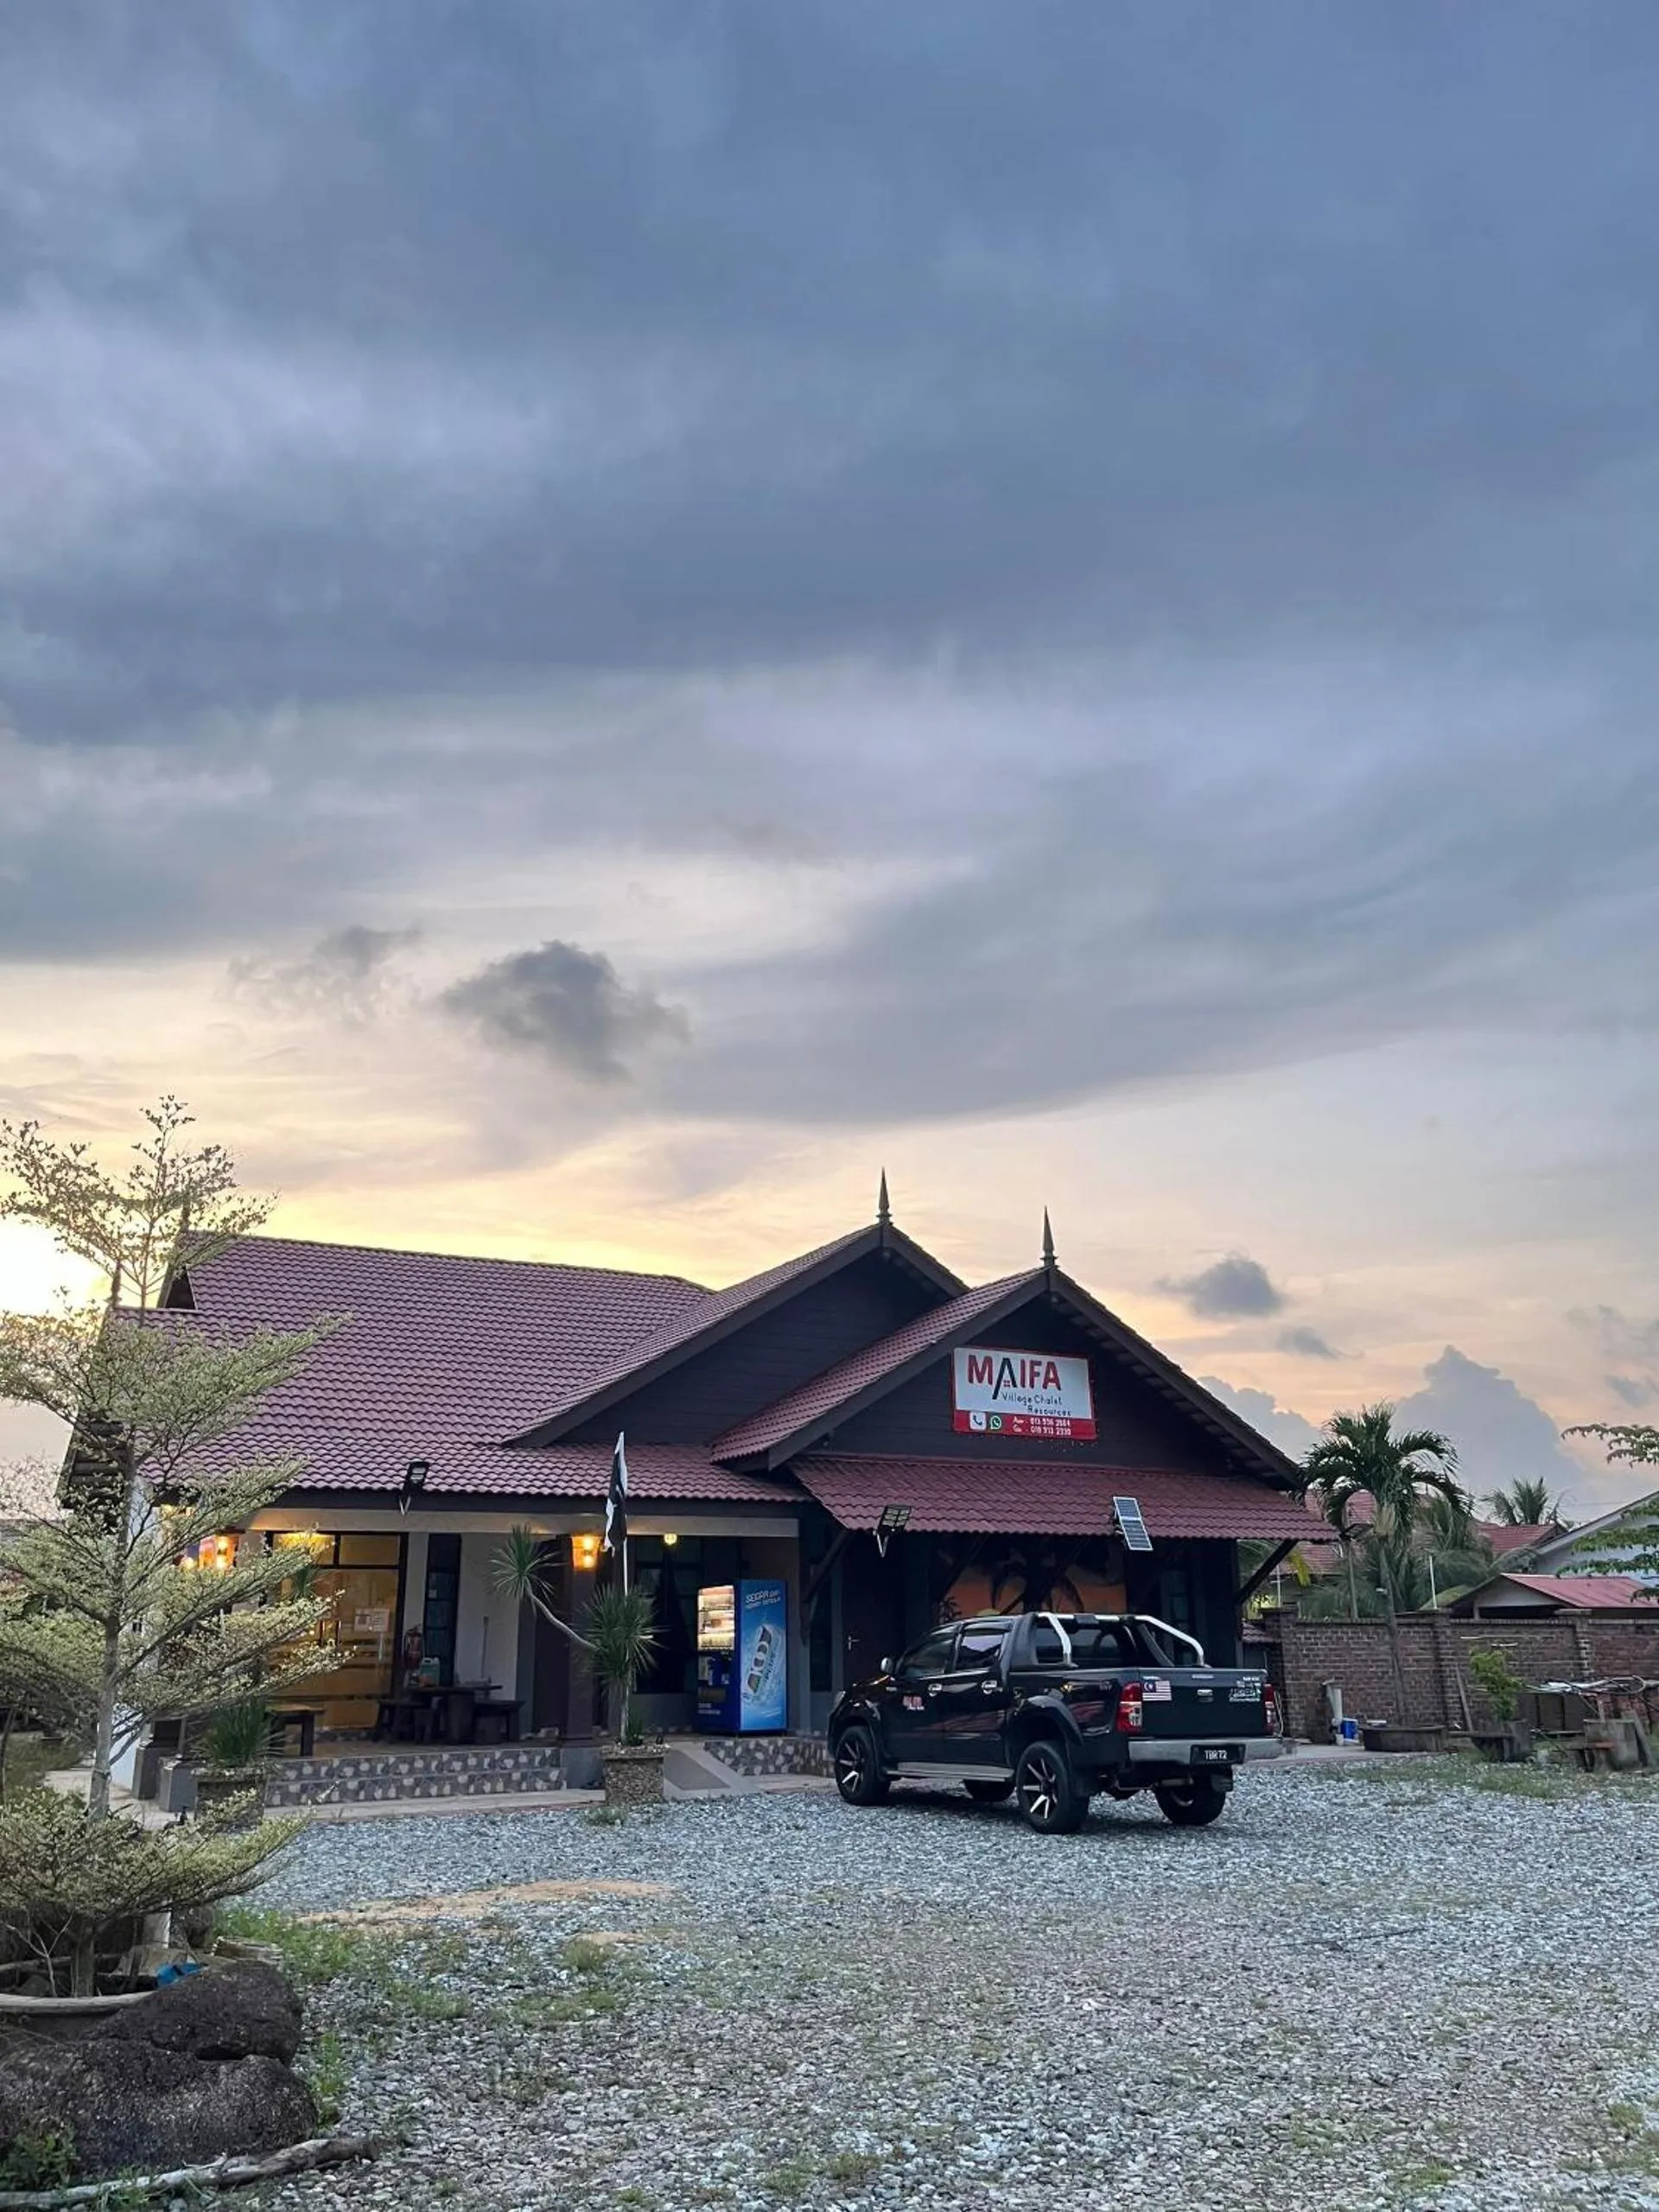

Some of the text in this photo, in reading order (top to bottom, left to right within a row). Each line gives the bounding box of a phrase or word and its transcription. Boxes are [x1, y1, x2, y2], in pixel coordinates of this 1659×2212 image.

[968, 1355, 1062, 1400] MAIFA
[1001, 1391, 1062, 1406] Village Chalet
[1027, 1405, 1072, 1417] Resources
